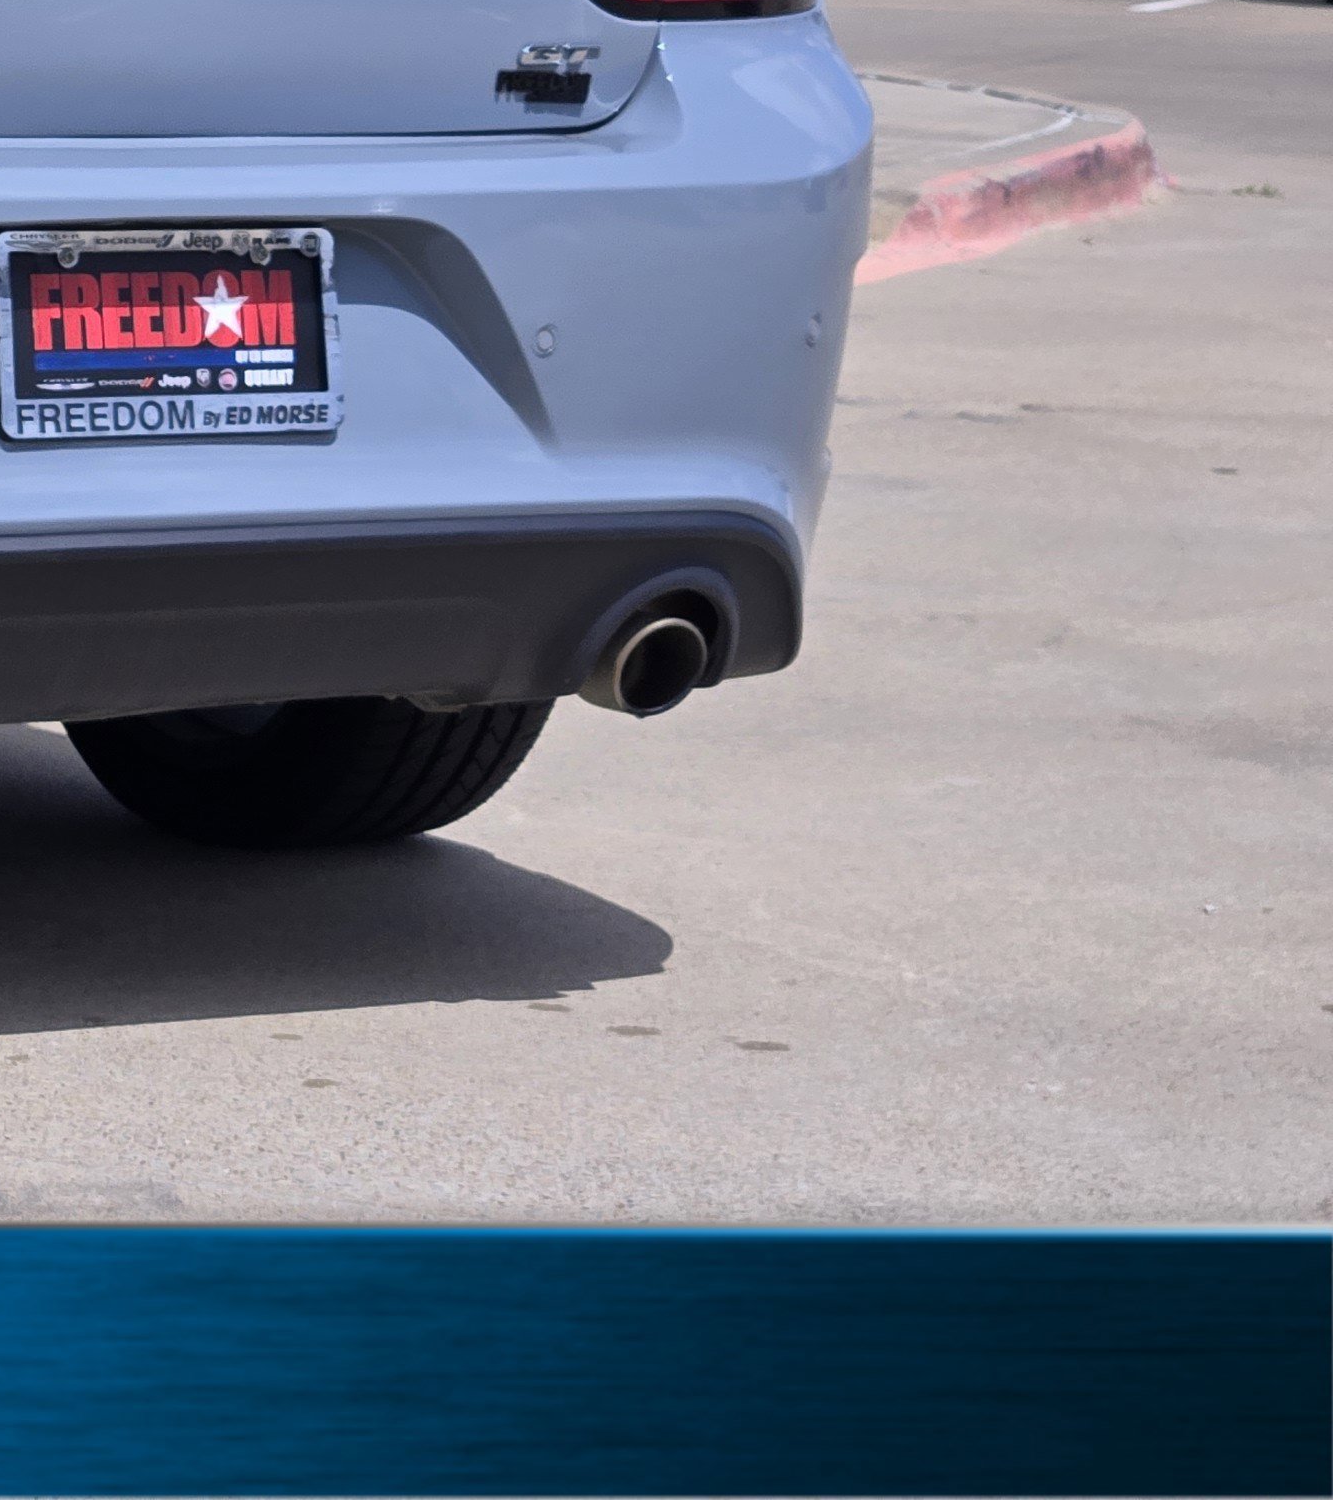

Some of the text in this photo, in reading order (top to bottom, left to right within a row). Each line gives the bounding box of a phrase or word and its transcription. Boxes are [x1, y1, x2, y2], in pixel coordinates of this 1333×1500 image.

[184, 232, 223, 249] Jeep
[30, 270, 296, 350] FREEDOM
[16, 400, 195, 435] FREEDOM
[225, 405, 251, 426] ED
[256, 404, 329, 424] MORSE
